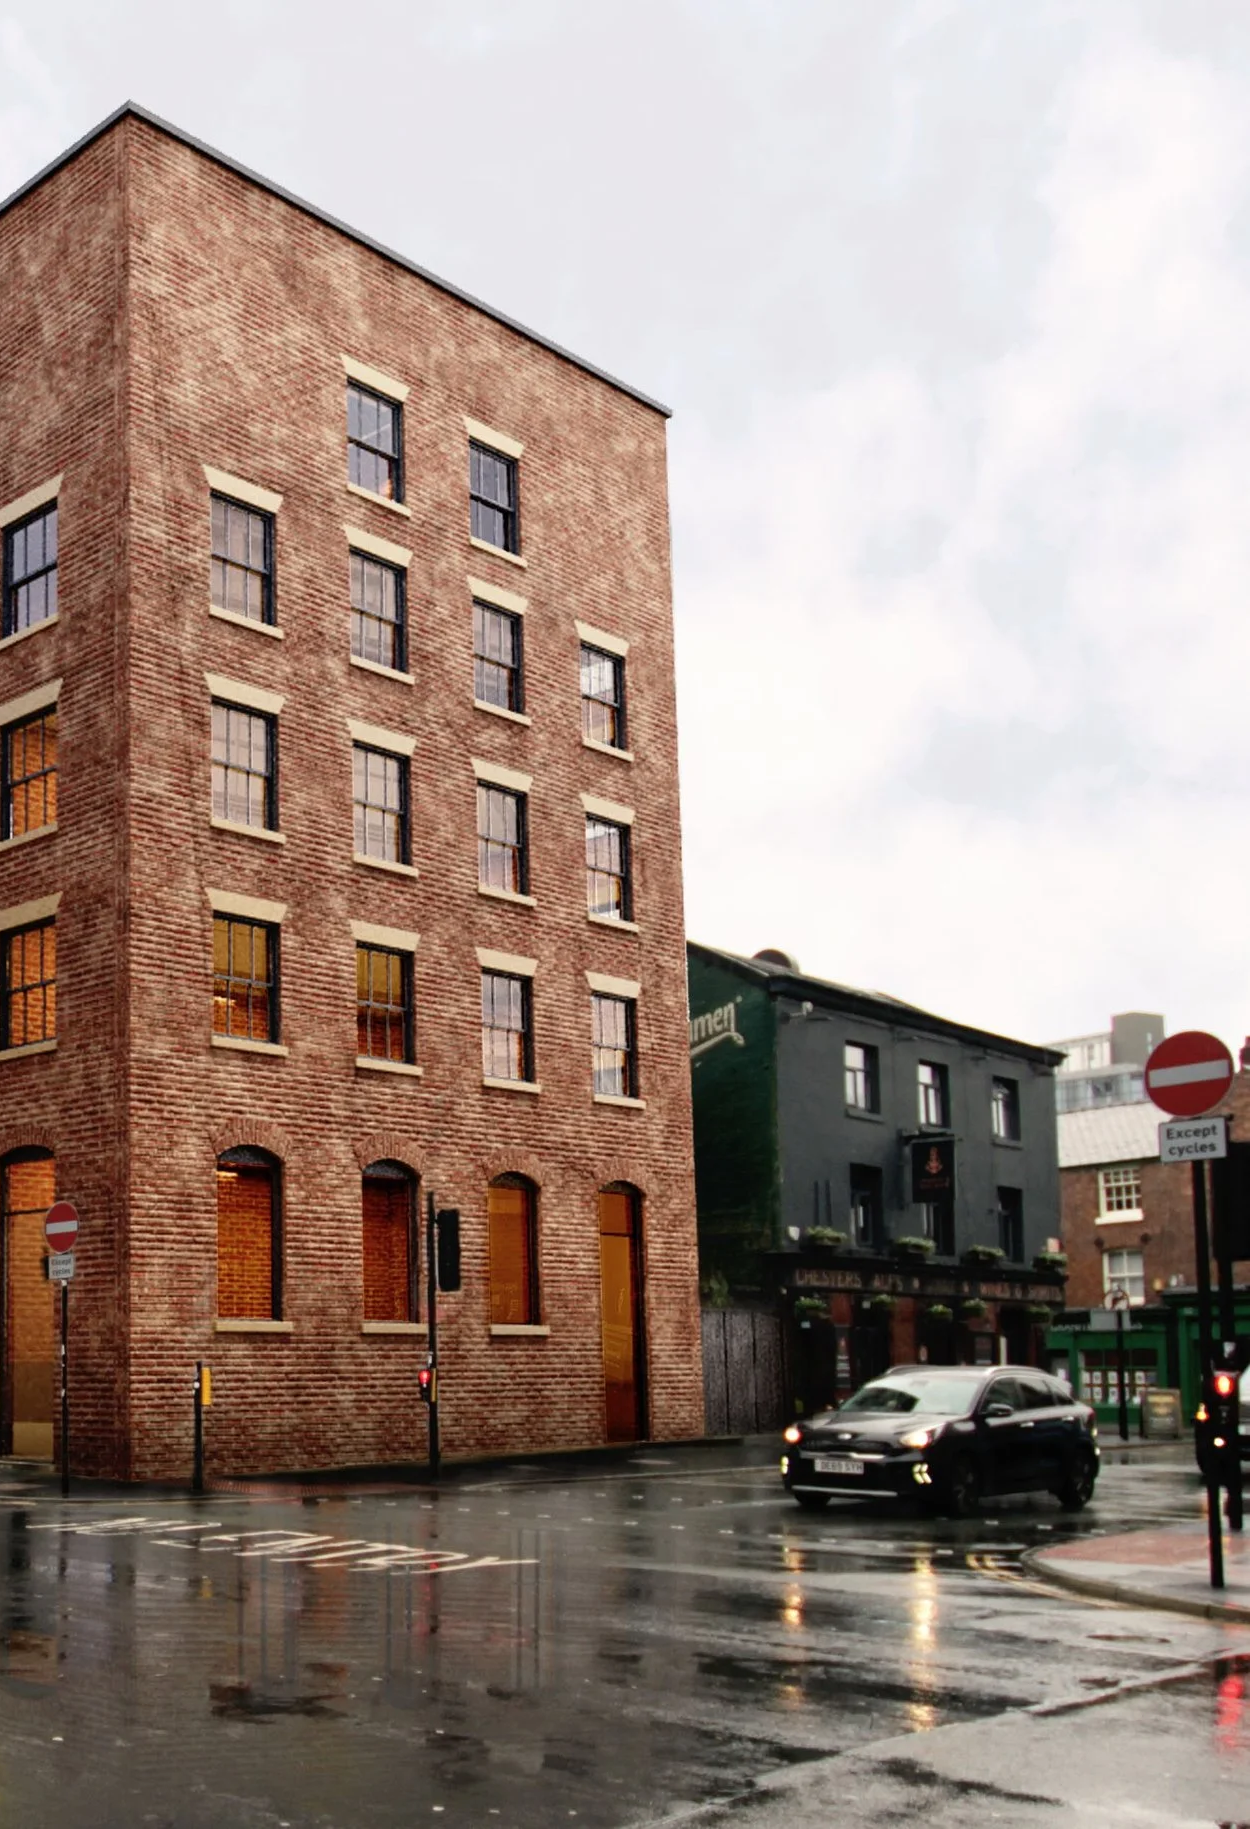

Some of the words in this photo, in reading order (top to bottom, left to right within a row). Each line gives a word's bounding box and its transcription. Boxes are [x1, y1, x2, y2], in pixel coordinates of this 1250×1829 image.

[690, 1002, 735, 1042] men
[1166, 1124, 1218, 1141] Except
[1168, 1142, 1216, 1158] cycles
[795, 1269, 862, 1289] CHESTERS
